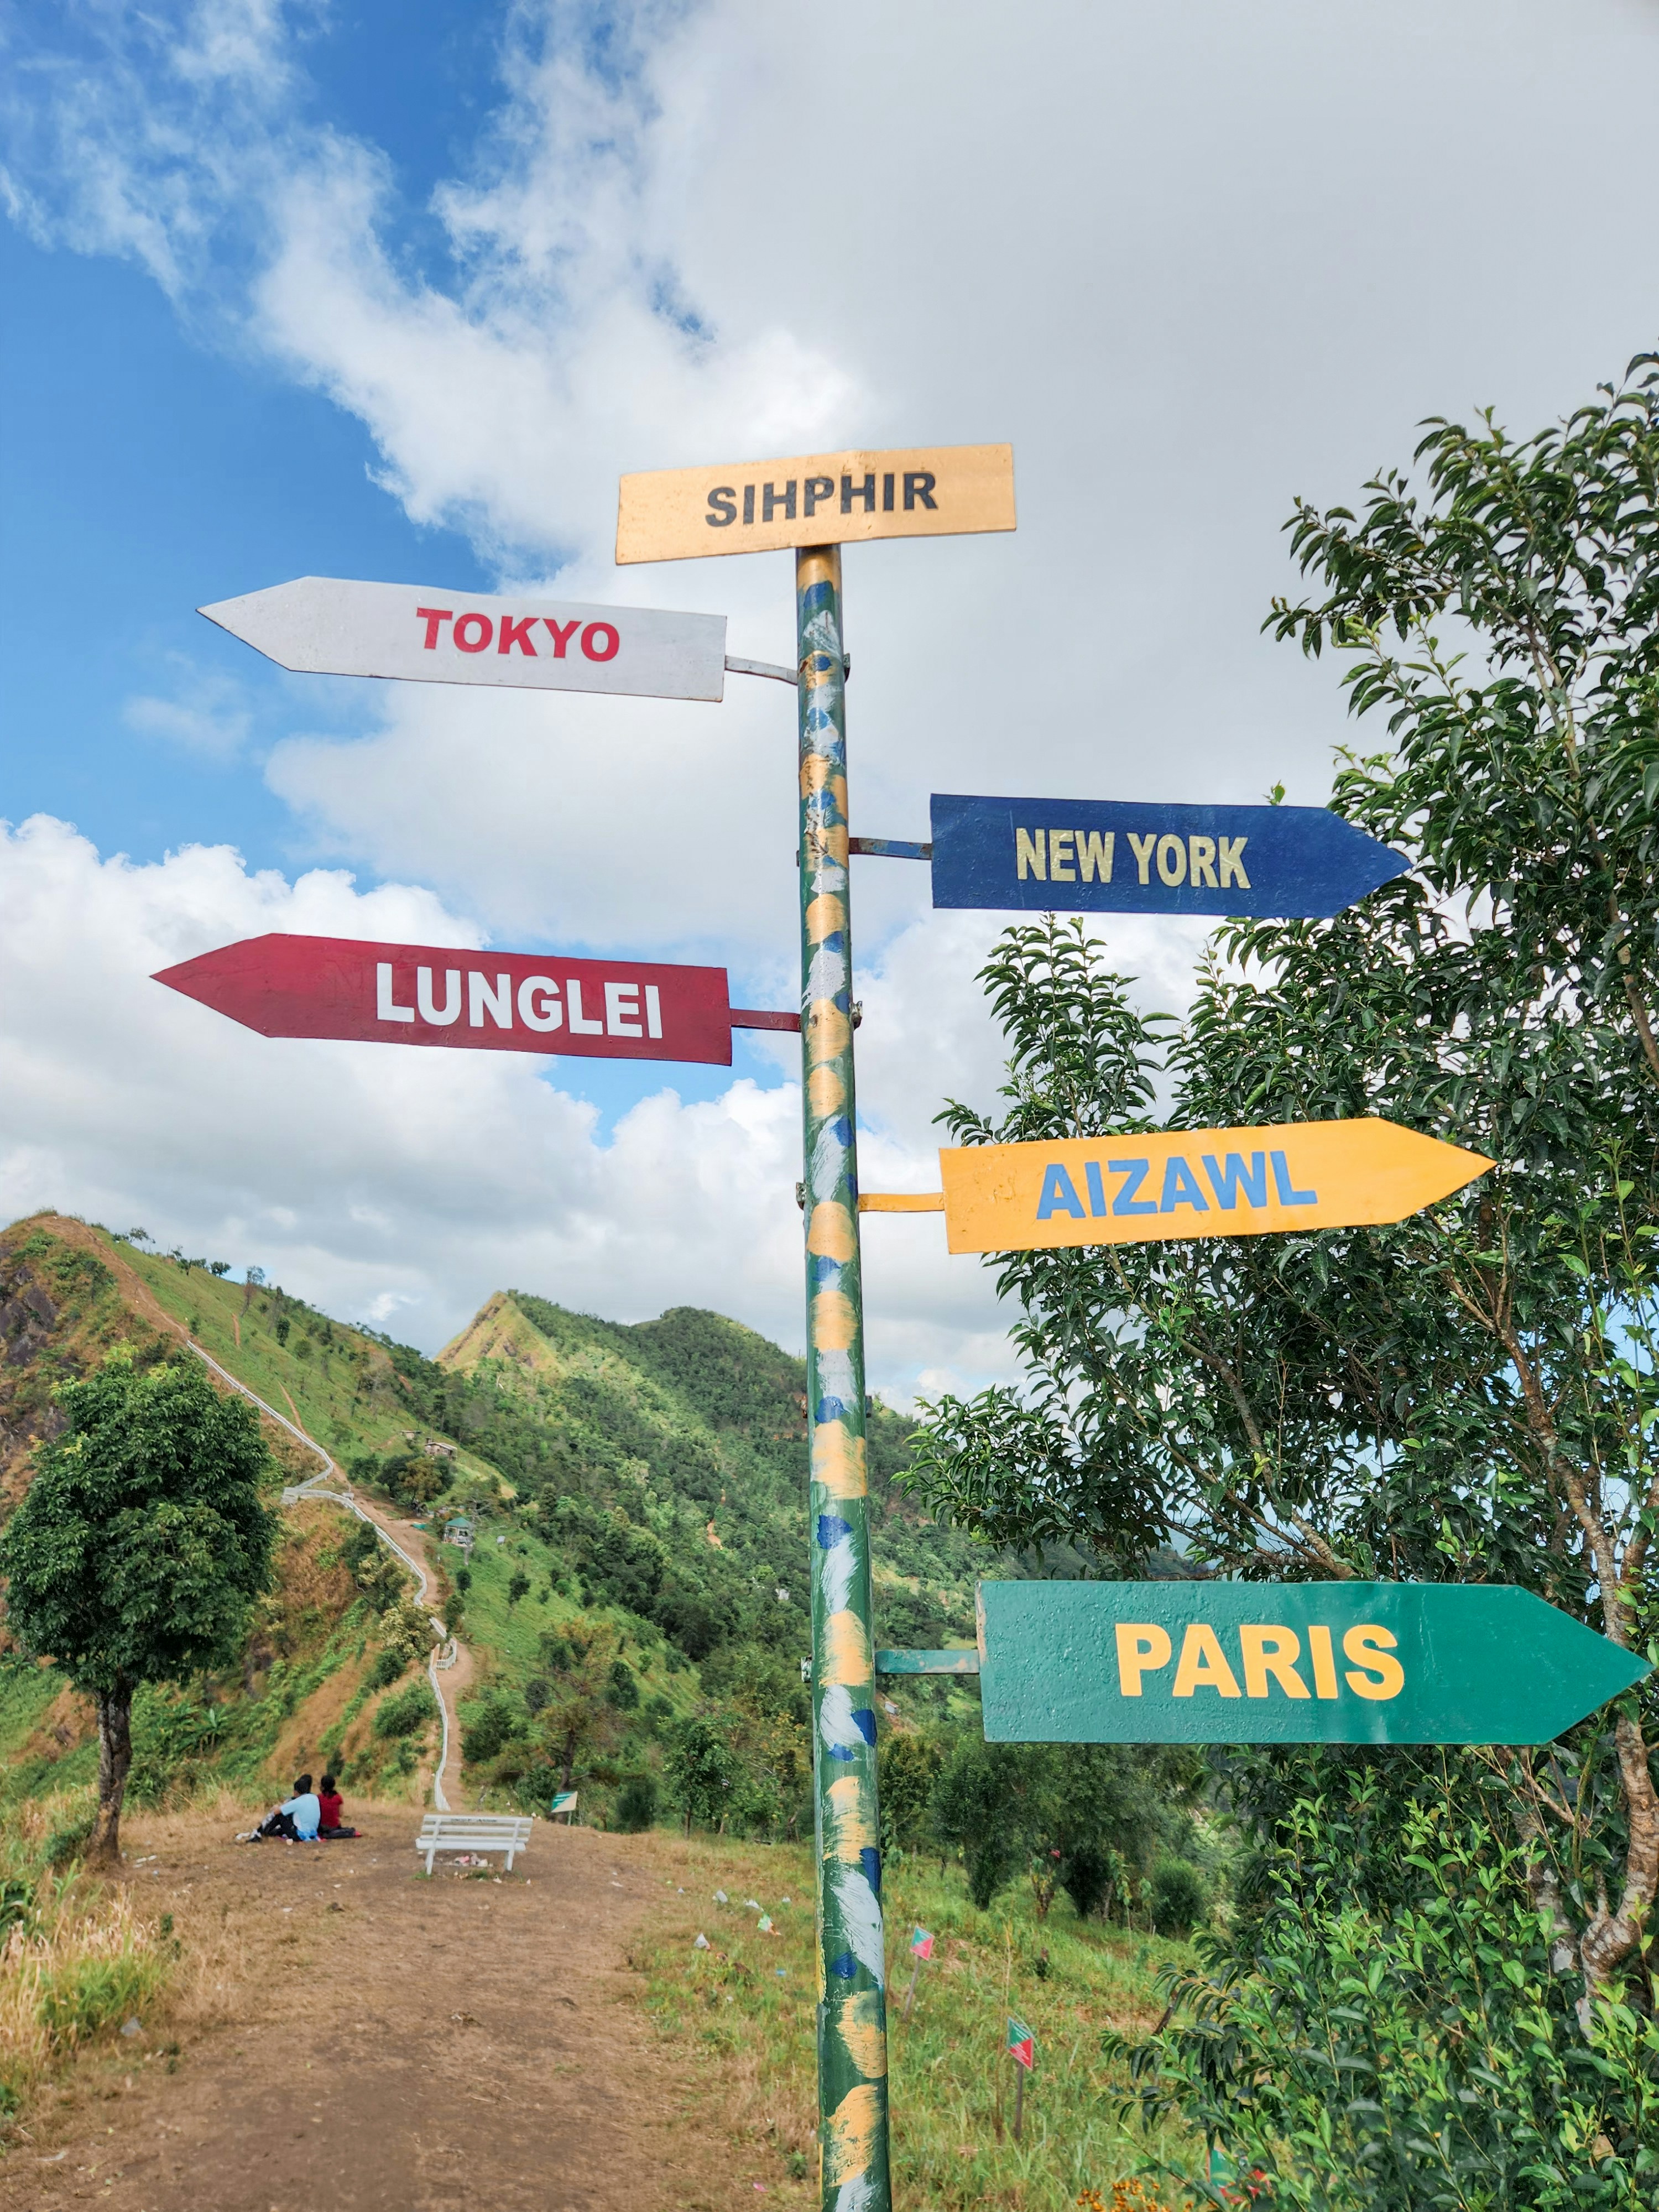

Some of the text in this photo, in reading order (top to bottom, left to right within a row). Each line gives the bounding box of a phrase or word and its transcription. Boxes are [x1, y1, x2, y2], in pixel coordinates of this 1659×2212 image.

[705, 471, 938, 527] SIHPHIR
[416, 607, 619, 662] TOKYO
[1016, 827, 1251, 889] NEW YORK
[376, 963, 662, 1039] LUNGLEI
[1036, 1150, 1317, 1219] AIZAWL
[1115, 1623, 1405, 1700] PARIS
